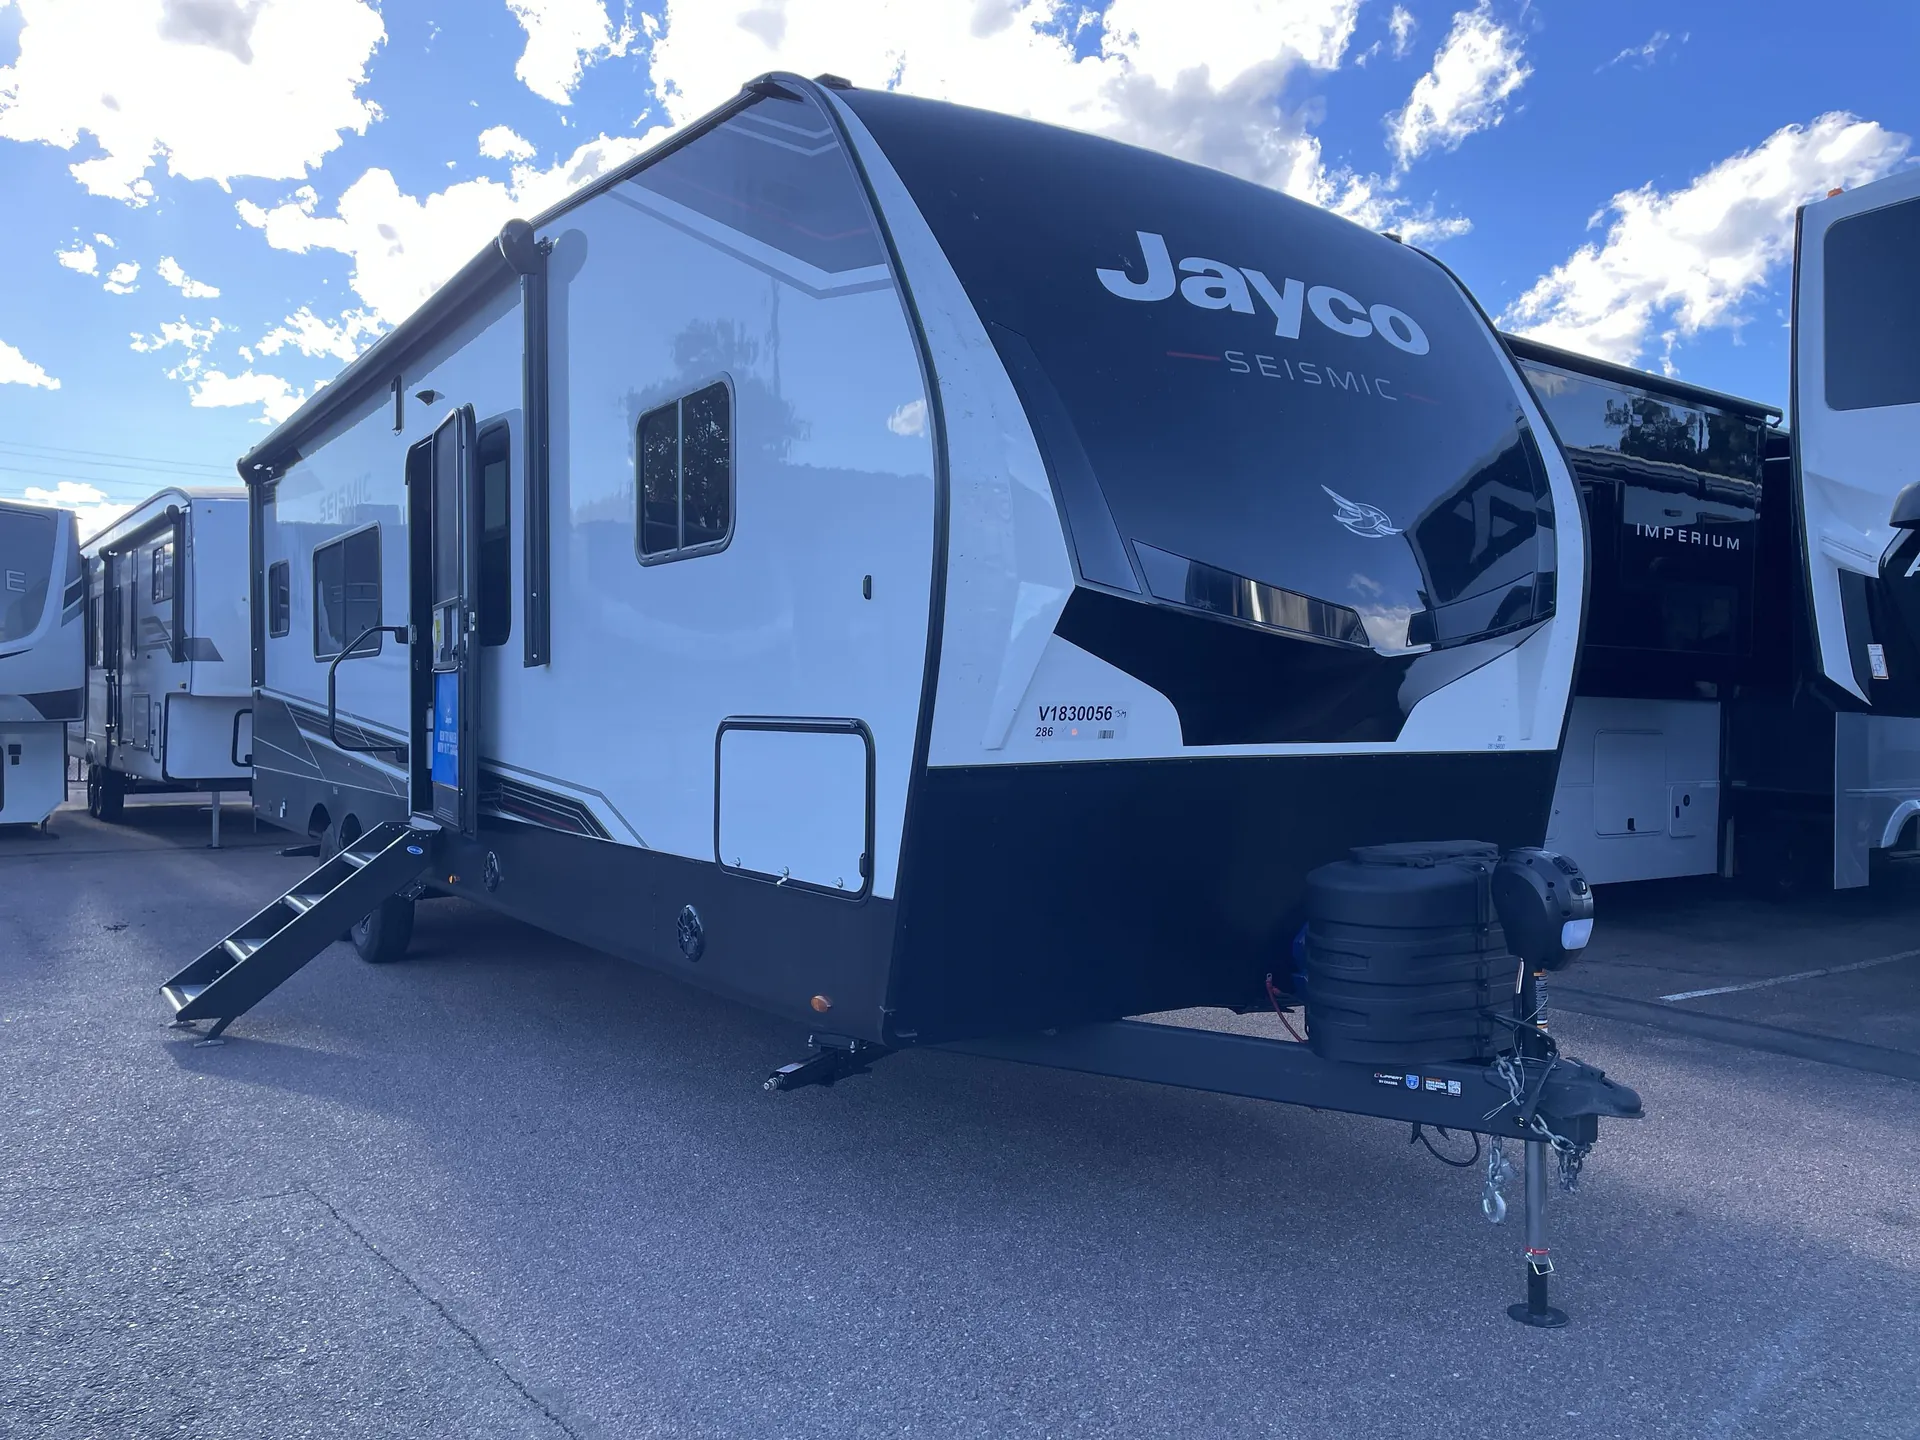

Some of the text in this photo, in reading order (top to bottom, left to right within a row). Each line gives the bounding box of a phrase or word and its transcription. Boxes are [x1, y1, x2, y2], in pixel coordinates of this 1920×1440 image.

[1095, 230, 1430, 356] Jayco
[1224, 350, 1398, 401] SEISMIC
[1636, 522, 1740, 551] IMPERIUM
[6, 569, 26, 593] E
[1038, 705, 1113, 721] V1830056
[1035, 726, 1054, 737] 286
